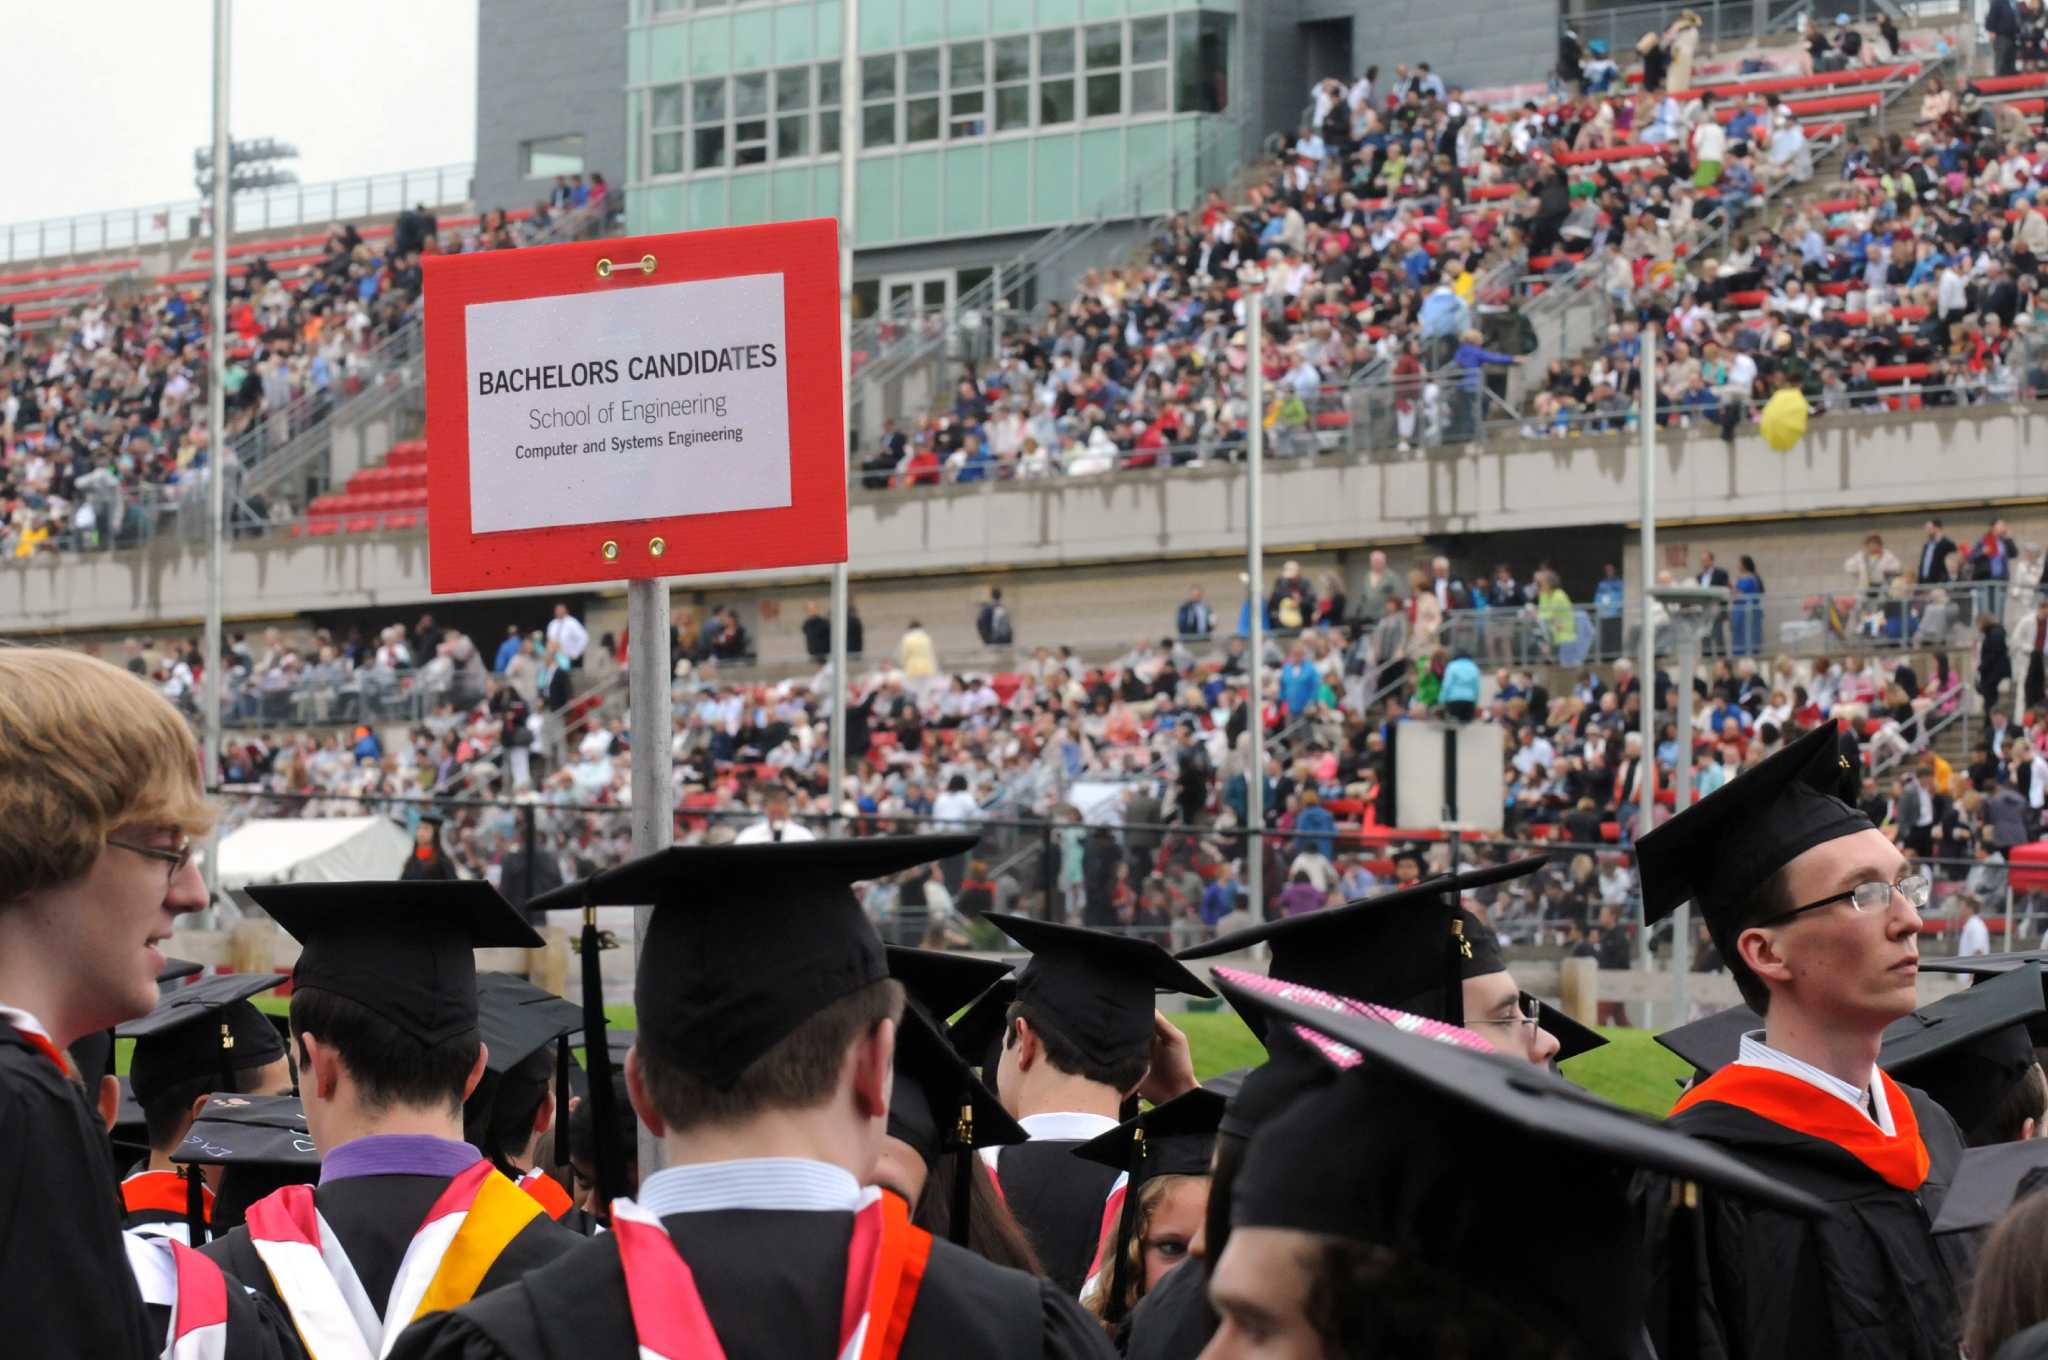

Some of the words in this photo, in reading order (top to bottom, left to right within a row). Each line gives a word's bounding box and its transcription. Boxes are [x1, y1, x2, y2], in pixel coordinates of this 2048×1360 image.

[480, 359, 619, 396] BACHELORS
[628, 343, 777, 381] CANDIDATES
[529, 404, 591, 430] School
[598, 401, 615, 424] of
[622, 393, 727, 424] Engineering
[515, 442, 578, 460] Computer
[583, 438, 606, 453] and
[611, 435, 664, 453] Systems
[668, 426, 743, 447] Engineering
